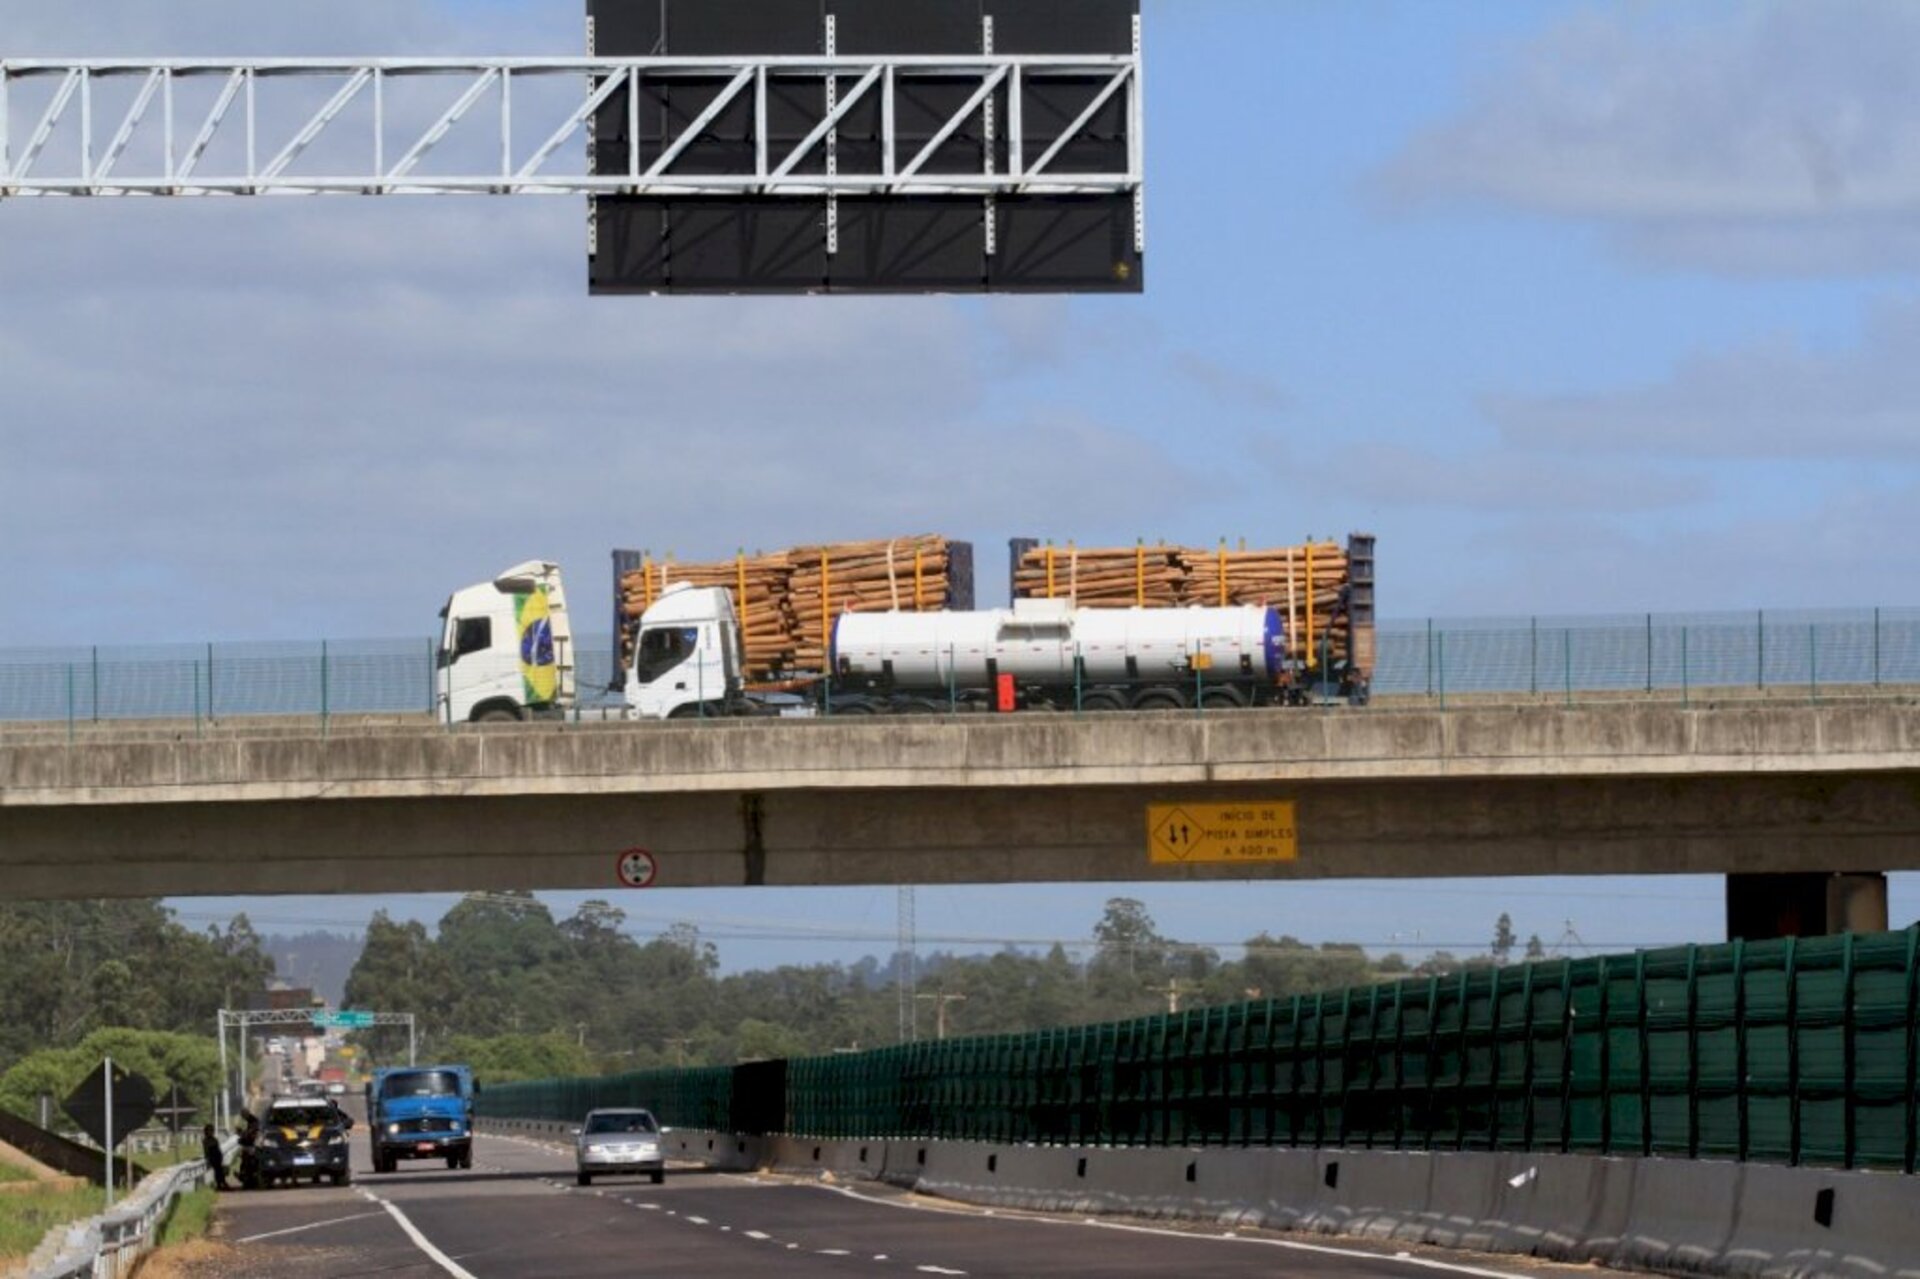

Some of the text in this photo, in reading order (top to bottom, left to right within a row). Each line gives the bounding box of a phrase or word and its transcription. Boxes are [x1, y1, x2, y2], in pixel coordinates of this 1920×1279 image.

[1261, 808, 1276, 821] DE
[1206, 827, 1294, 841] PISTA SIMPLES
[1223, 845, 1233, 856] A
